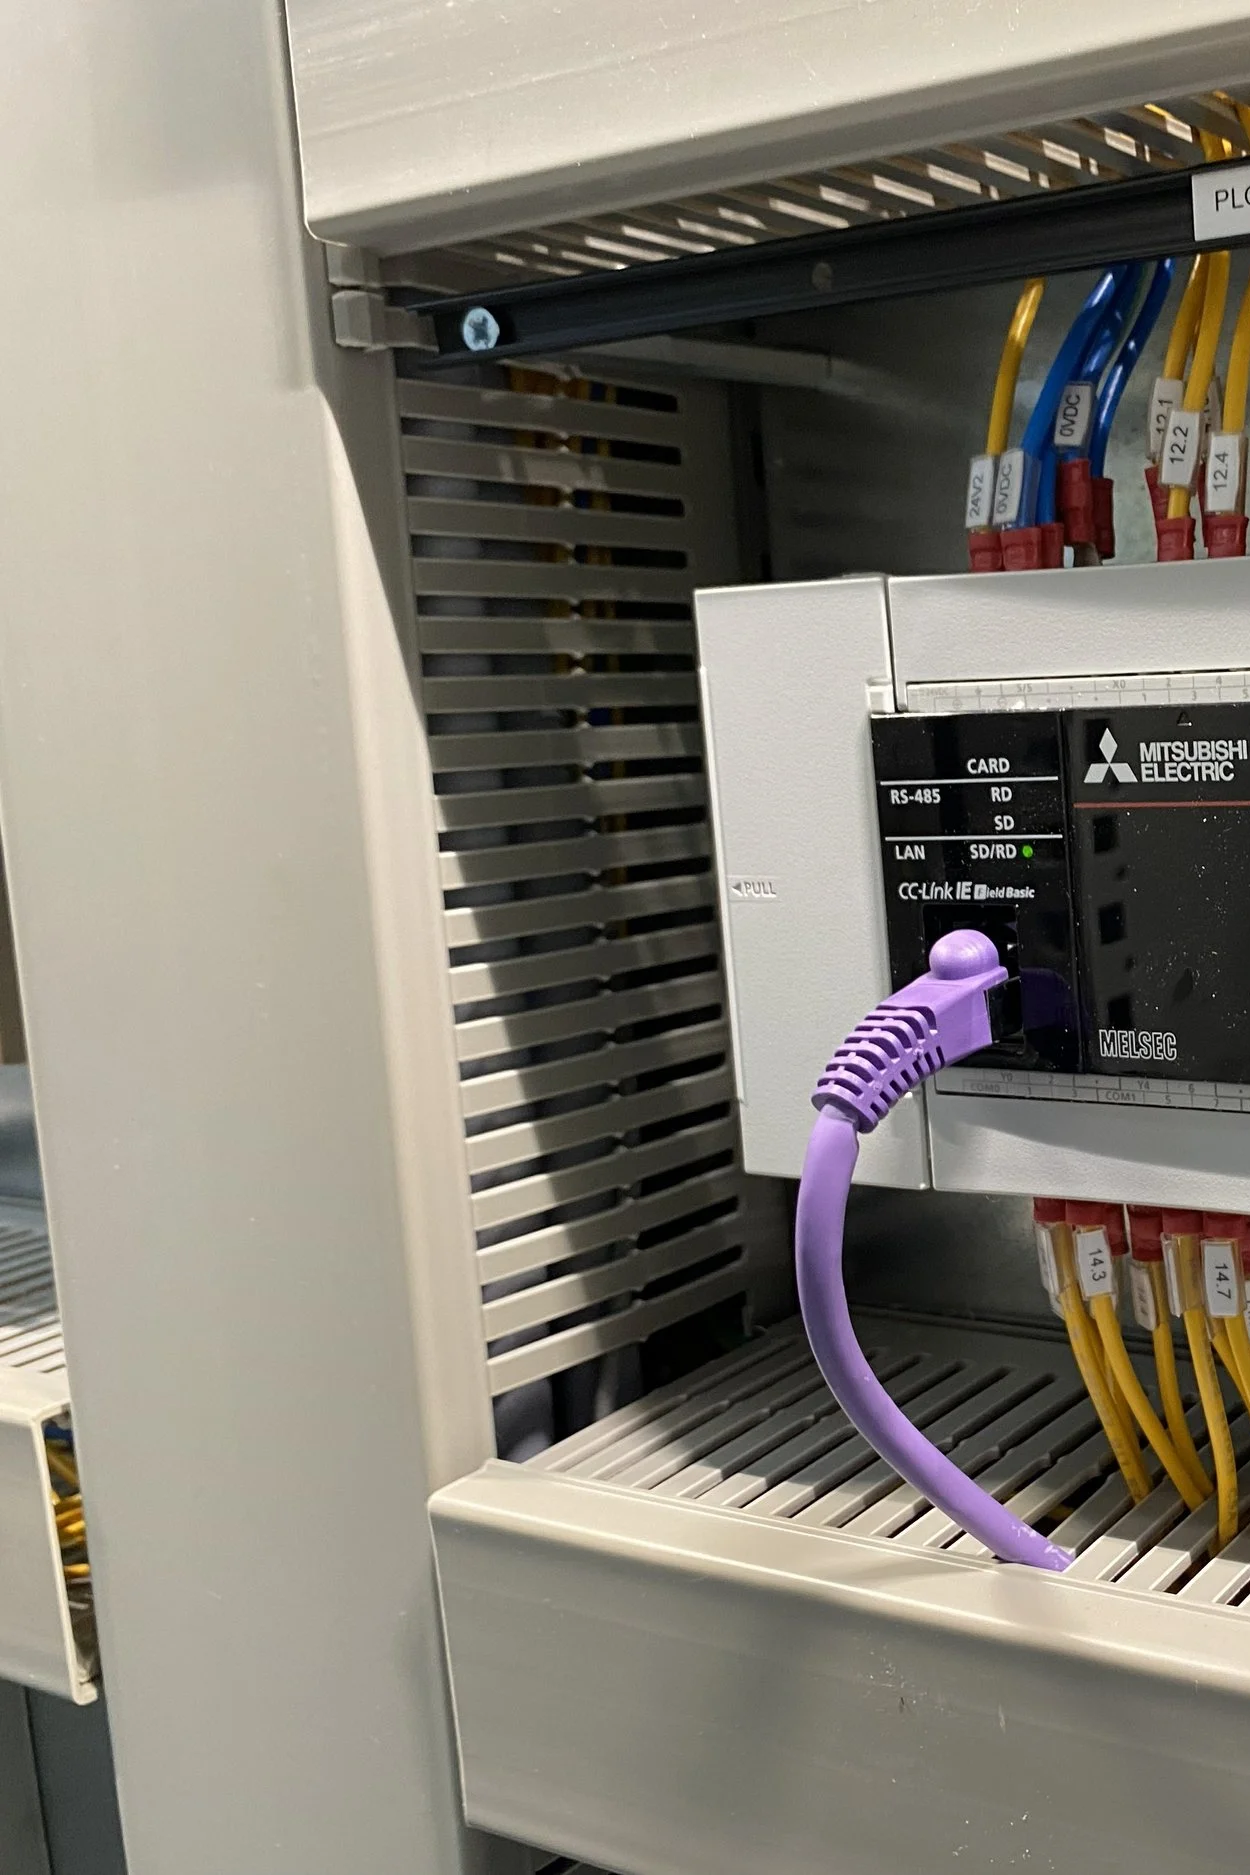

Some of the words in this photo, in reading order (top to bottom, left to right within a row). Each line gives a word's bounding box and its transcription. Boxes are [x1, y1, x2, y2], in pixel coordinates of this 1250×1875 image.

[1169, 426, 1188, 464] 12.2
[1213, 452, 1229, 491] 12.4
[969, 474, 984, 518] 24V2
[1112, 679, 1126, 689] X0
[1165, 677, 1172, 687] 2
[1215, 675, 1222, 685] 4
[1191, 690, 1197, 701] 3
[1242, 688, 1249, 698] 5
[1139, 739, 1248, 762] MITSUBISHI
[967, 757, 1010, 774] CARD
[1140, 761, 1235, 783] ELECTRIC
[890, 788, 941, 805] RS-485
[991, 786, 1012, 802] RD
[994, 815, 1015, 831] SD
[895, 845, 926, 860] LAN
[969, 843, 1017, 860] SD/RD
[743, 881, 776, 898] PULL
[956, 881, 973, 900] IE
[1006, 886, 1035, 898] Basic
[1099, 1030, 1177, 1060] MELSEC
[1138, 1079, 1150, 1089] Y4
[1188, 1083, 1195, 1093] 6
[1072, 1088, 1078, 1098] 3
[1105, 1090, 1137, 1102] COM1
[1164, 1094, 1171, 1105] 5
[1089, 1248, 1106, 1282] 14.3
[1215, 1263, 1232, 1300] 14.7
